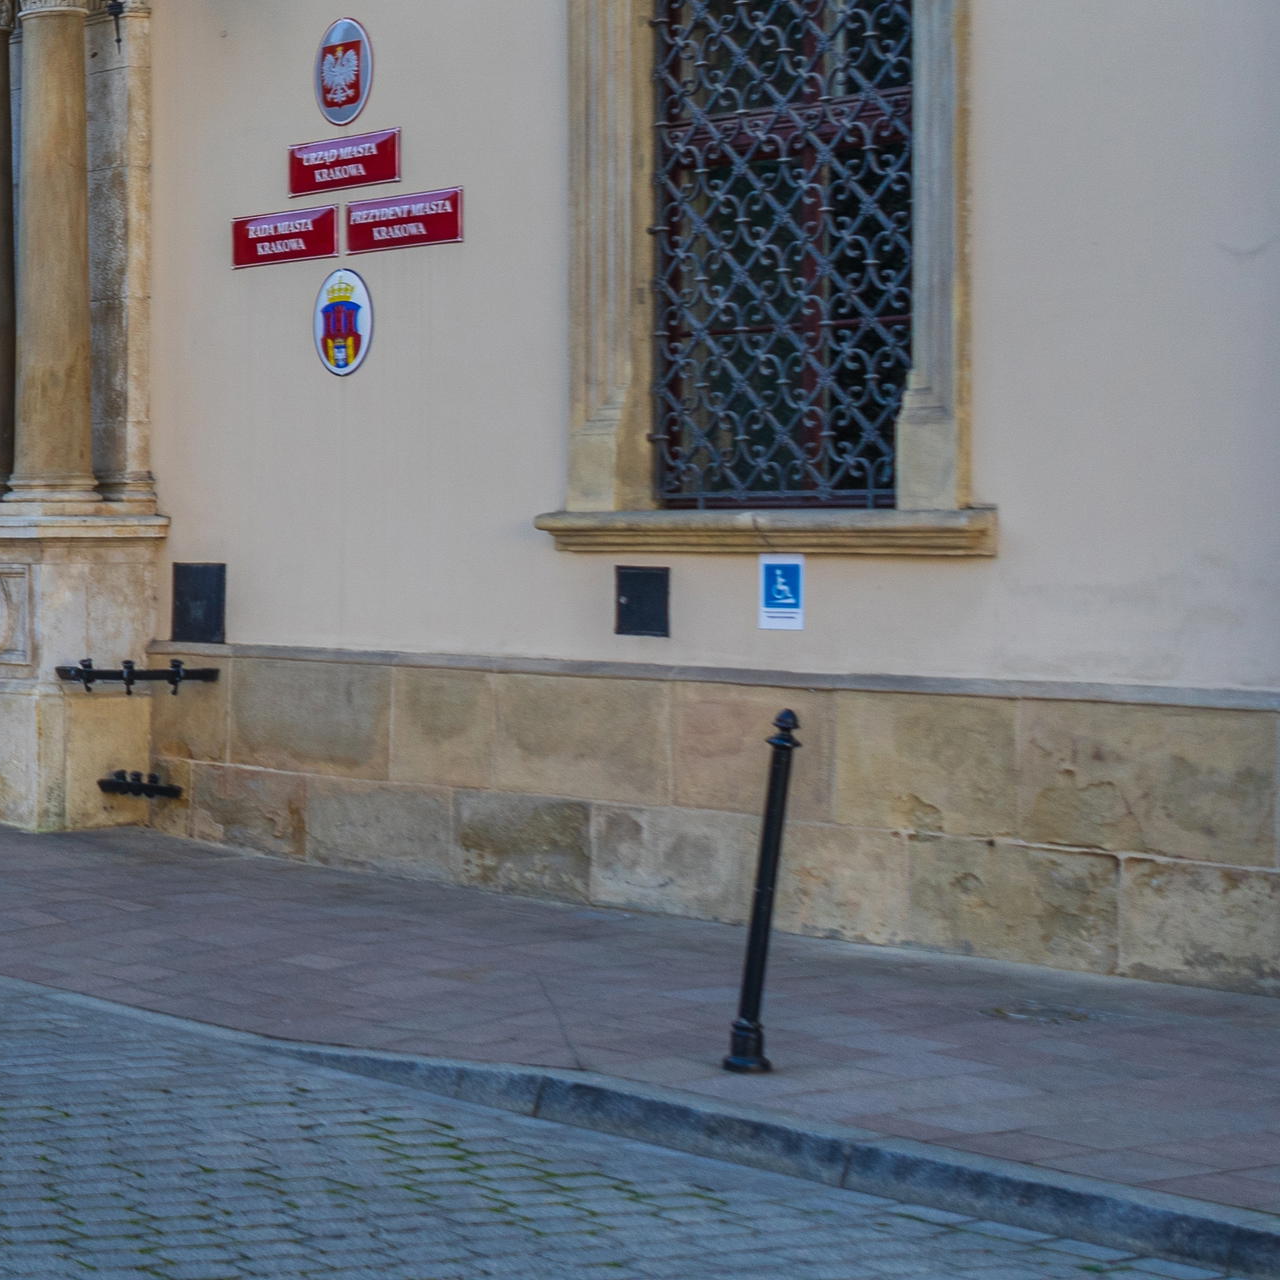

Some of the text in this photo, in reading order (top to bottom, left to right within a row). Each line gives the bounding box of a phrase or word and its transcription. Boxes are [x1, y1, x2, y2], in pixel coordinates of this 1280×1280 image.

[303, 143, 377, 166] URZĄD MIASTA
[314, 163, 366, 182] KRAKOWA
[350, 200, 453, 225] PREZYDENT MIASTA
[248, 219, 314, 239] RADA MIASTA
[372, 222, 427, 240] KRAKOWA
[256, 238, 307, 255] KRAKOWA
